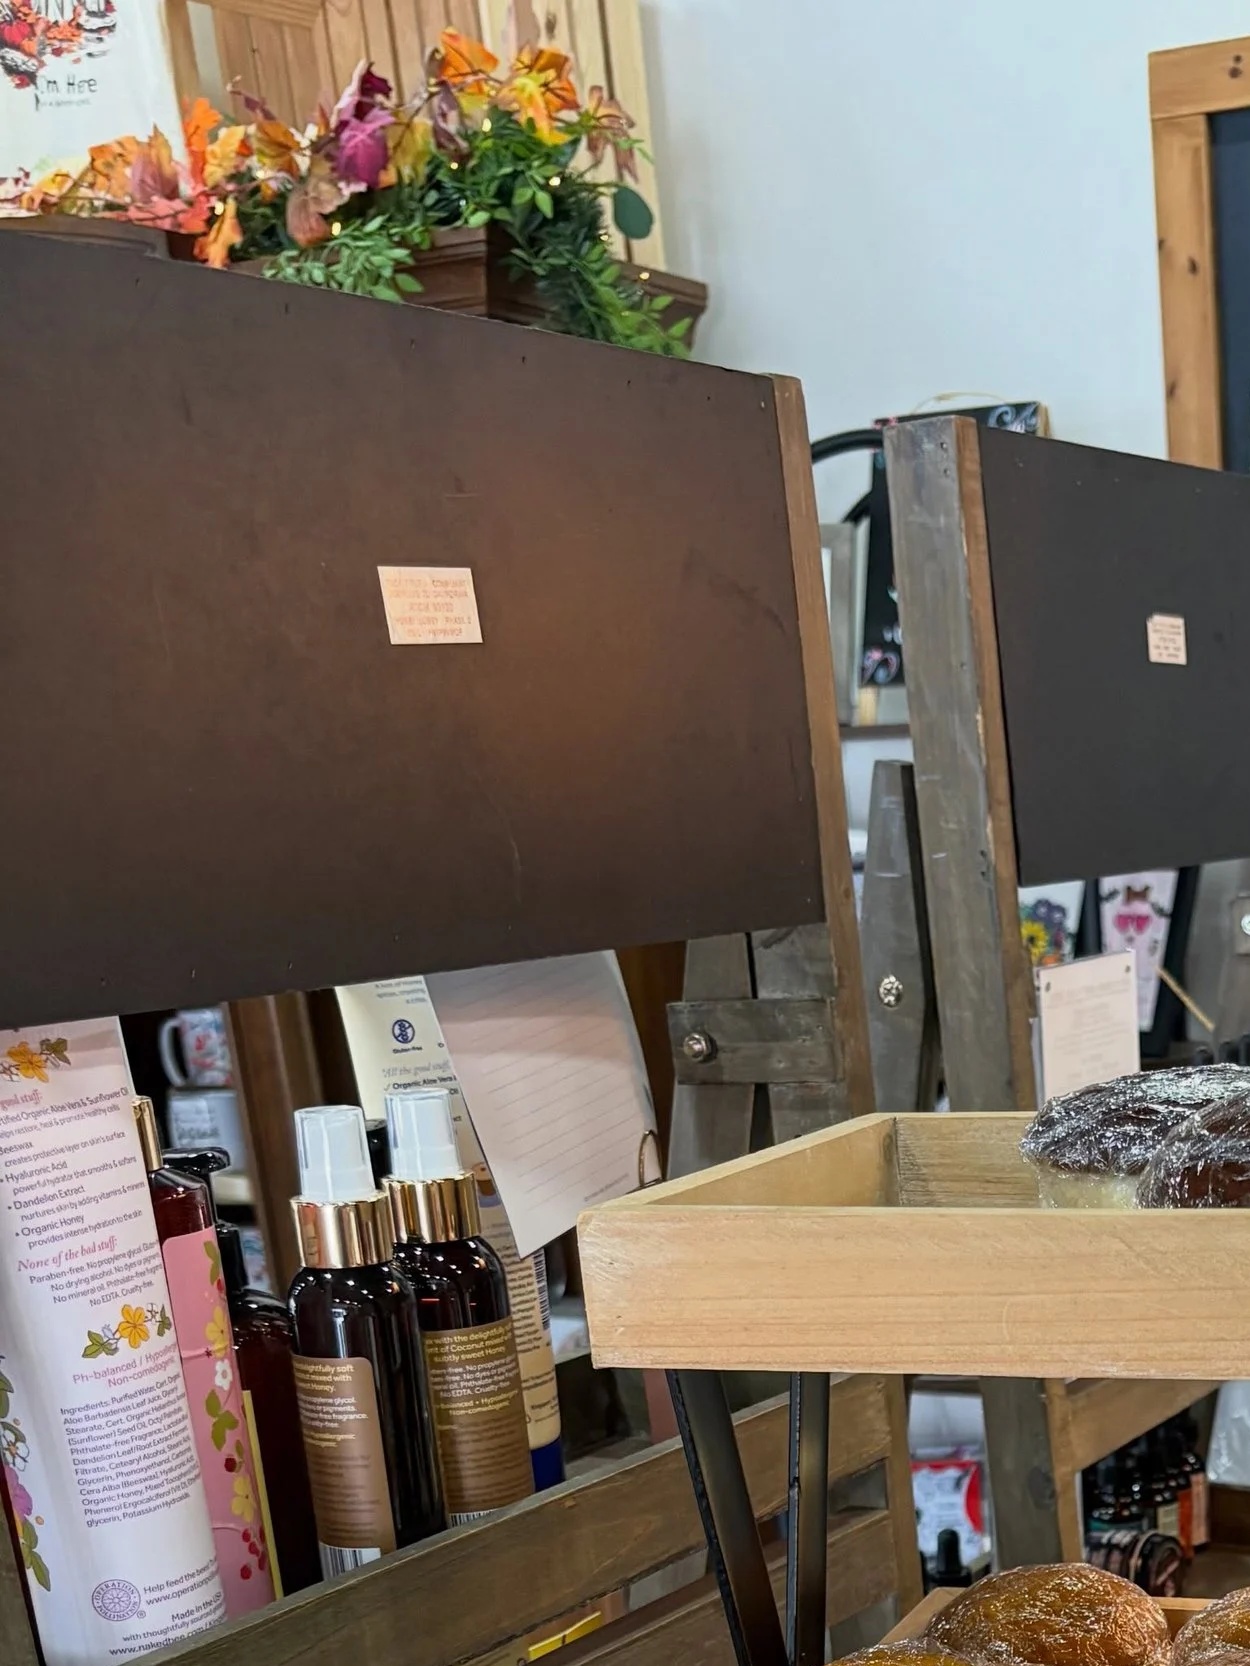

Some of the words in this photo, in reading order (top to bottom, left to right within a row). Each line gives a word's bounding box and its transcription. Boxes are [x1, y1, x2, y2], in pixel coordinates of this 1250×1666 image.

[392, 1081, 421, 1089] Organic
[21, 1107, 50, 1121] Organic
[86, 1090, 121, 1107] Sunflower
[5, 1156, 33, 1168] creates
[33, 1146, 65, 1163] protective
[5, 1164, 50, 1184] Hyaluronic
[51, 1160, 68, 1171] Acid
[13, 1179, 46, 1196] powerful
[14, 1190, 58, 1210] Dandelion
[58, 1185, 85, 1199] Extract
[21, 1207, 56, 1222] nurtures
[21, 1221, 59, 1237] Organic
[60, 1214, 85, 1228] Honey
[28, 1233, 64, 1250] provides
[64, 1226, 89, 1239] intense
[17, 1256, 49, 1272] None
[65, 1247, 79, 1261] the
[80, 1242, 96, 1255] bad
[98, 1235, 117, 1253] stuff:
[51, 1281, 64, 1292] No
[65, 1274, 90, 1291] drying
[53, 1293, 67, 1304] No
[68, 1285, 96, 1300] mineral
[89, 1297, 101, 1307] No
[450, 1341, 484, 1352] Coconut
[453, 1334, 468, 1342] the
[461, 1351, 485, 1360] sweet
[72, 1359, 137, 1384] Ph-balanced
[336, 1364, 354, 1372] soft
[60, 1399, 109, 1416] Ingredients:
[63, 1417, 83, 1425] Aloe
[84, 1405, 131, 1422] Barbadensis
[70, 1438, 130, 1456] Phthalate-free
[72, 1452, 117, 1466] Dandelion
[77, 1474, 116, 1487] Glycerin,
[80, 1486, 101, 1496] Cera
[102, 1480, 121, 1493] Alba
[82, 1494, 116, 1507] Organic
[86, 1513, 122, 1528] glycerin,
[144, 1583, 165, 1595] Help
[165, 1576, 184, 1589] feed
[171, 1609, 195, 1622] Made
[122, 1631, 142, 1642] with
